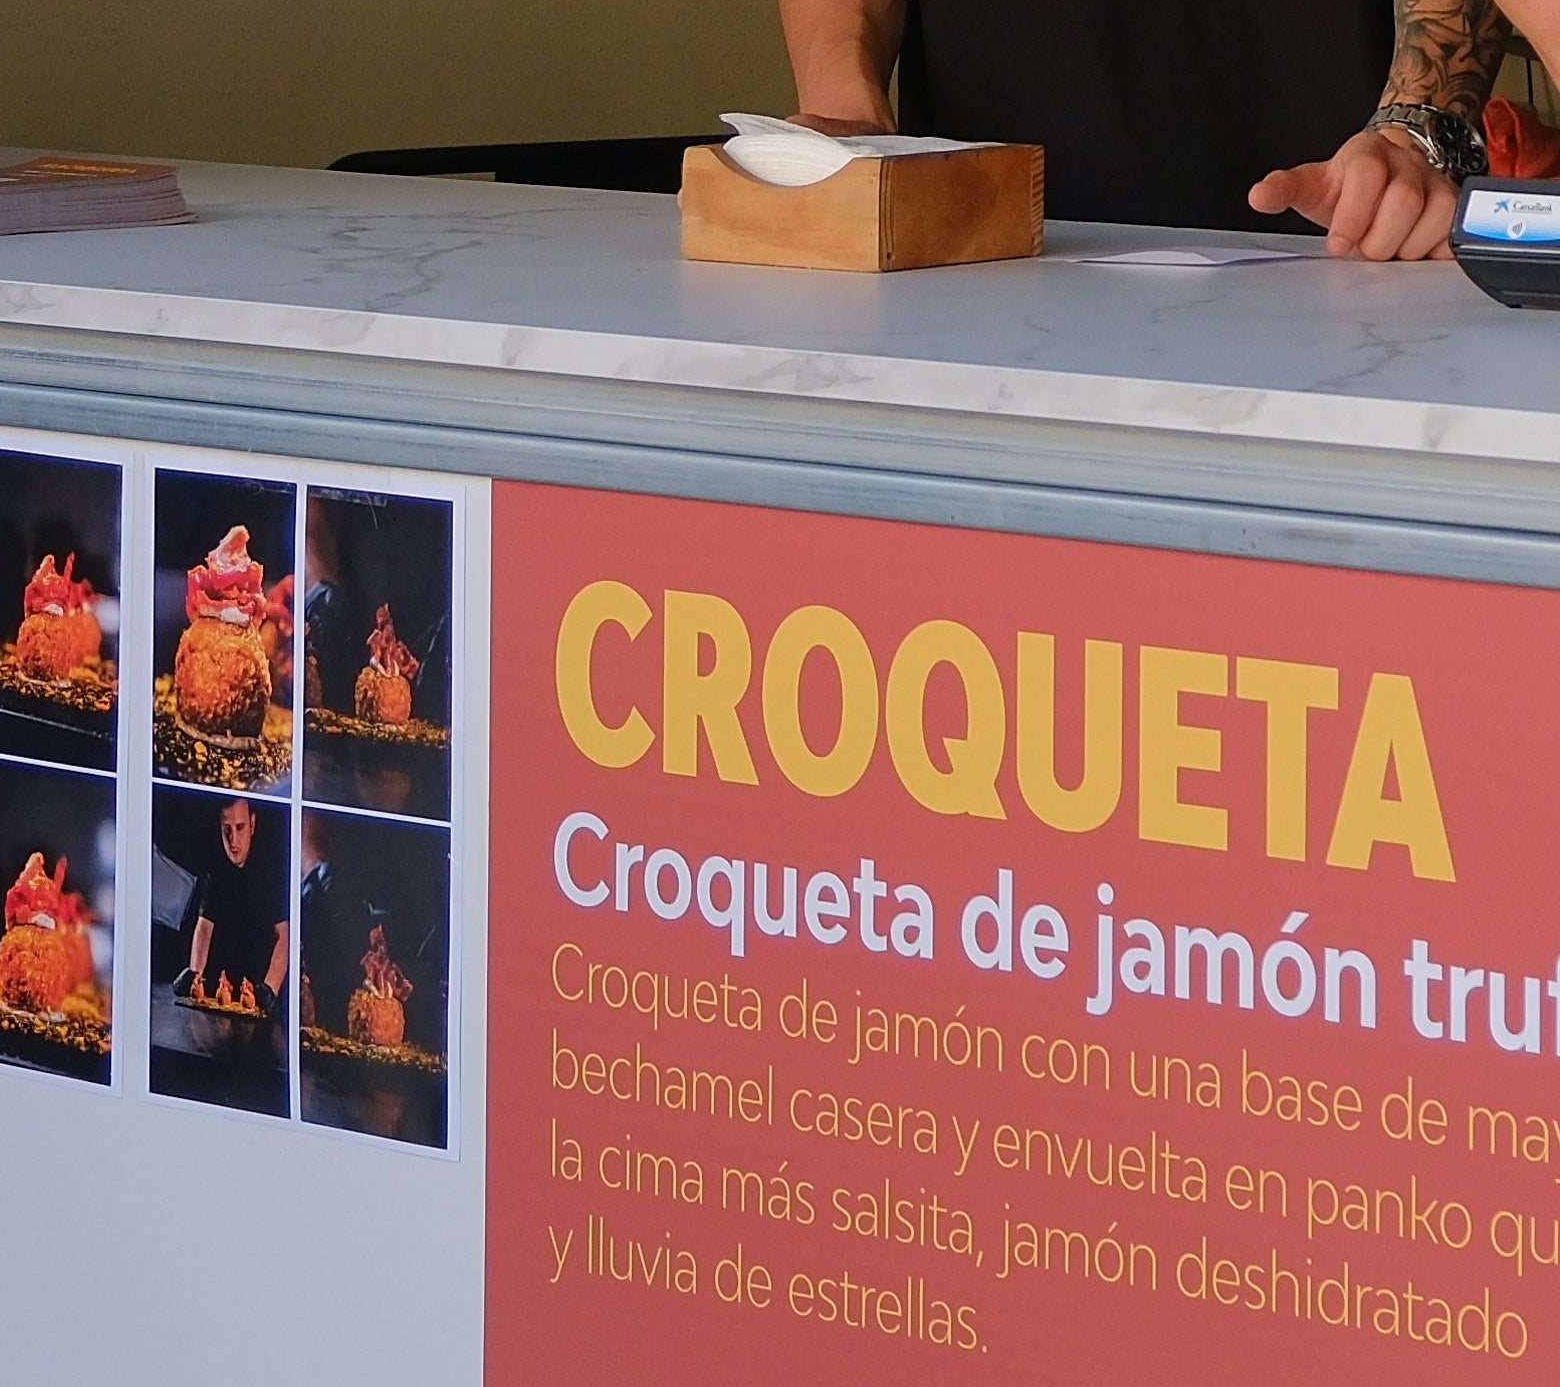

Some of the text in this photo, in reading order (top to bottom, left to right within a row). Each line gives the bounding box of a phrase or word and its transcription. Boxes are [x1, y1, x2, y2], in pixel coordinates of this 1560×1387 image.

[554, 579, 1457, 883] CROQUETA
[553, 811, 935, 960] Croqueta
[960, 867, 1070, 979] de
[1085, 882, 1377, 1029] jamón
[551, 943, 762, 1032] Croqueta
[778, 978, 838, 1044] de
[847, 989, 1005, 1072] jamón
[1021, 1033, 1110, 1091] con
[1129, 1051, 1222, 1110] una
[1241, 1049, 1363, 1132] base
[1380, 1076, 1448, 1146] de
[552, 1027, 774, 1126] bechamel
[789, 1087, 938, 1156] casera
[951, 1115, 981, 1177] y
[992, 1123, 1208, 1204] envuelta
[1225, 1162, 1288, 1218] en
[1307, 1174, 1473, 1251] panko
[548, 1213, 990, 1355] y lluvia de estrellas.
[551, 1117, 1530, 1360] la cima más salsita, jamón deshidratado
